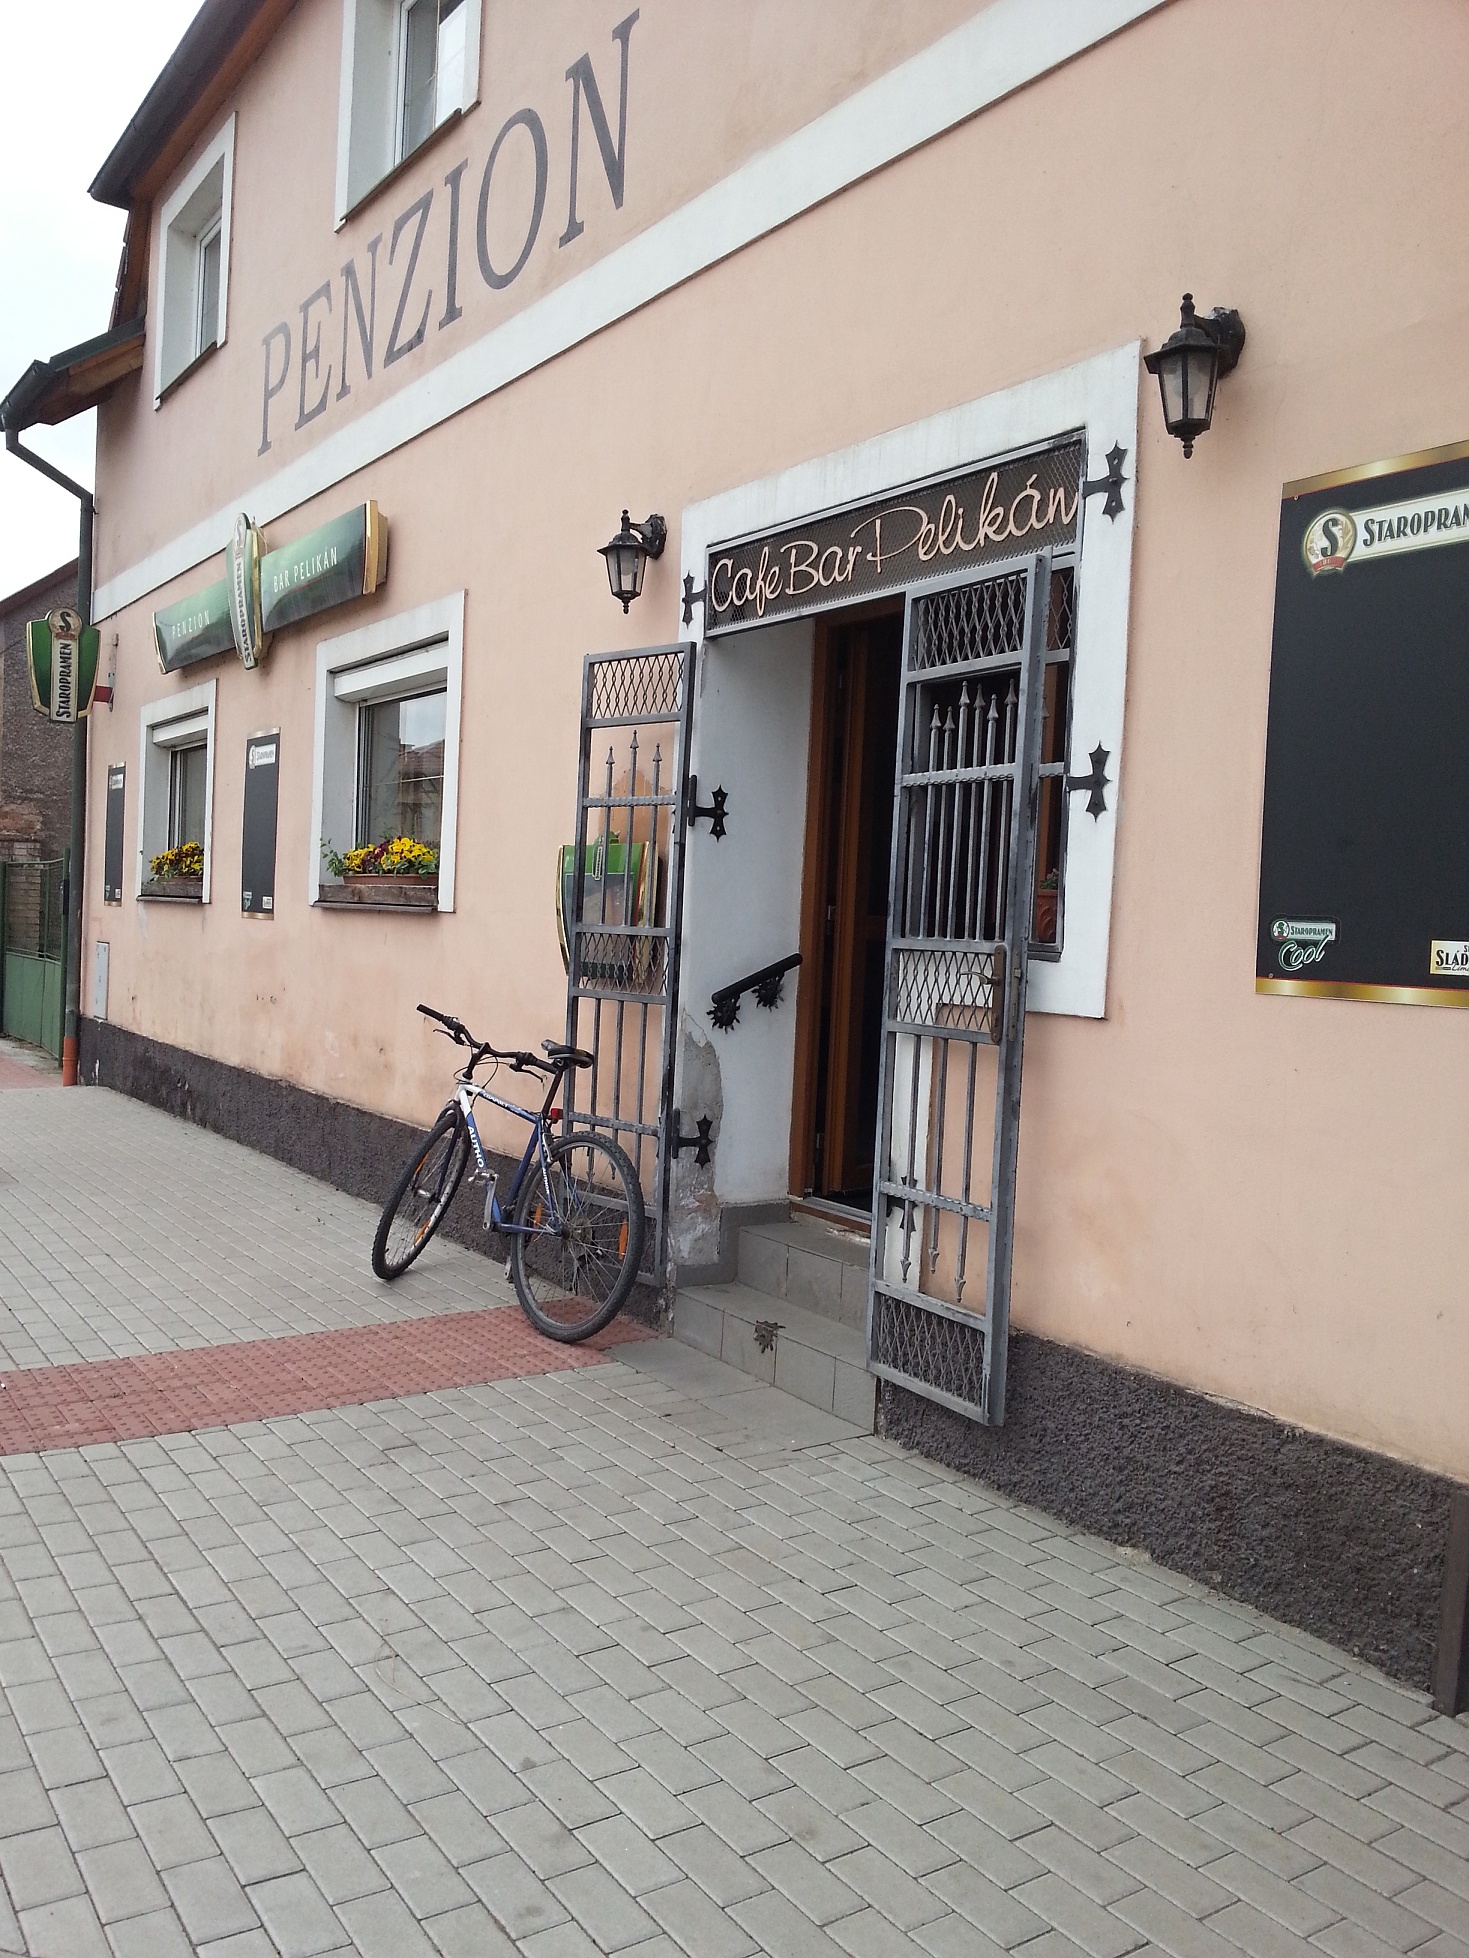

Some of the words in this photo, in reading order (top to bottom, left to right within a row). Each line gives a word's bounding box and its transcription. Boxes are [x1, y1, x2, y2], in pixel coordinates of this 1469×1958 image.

[257, 8, 640, 458] PENZION
[711, 546, 783, 617] Cafe
[780, 540, 862, 595] Bar
[850, 472, 1079, 574] Pelikán
[273, 575, 290, 593] BAR
[293, 546, 337, 583] PELIKÁN
[172, 610, 210, 640] PENZION
[56, 642, 72, 719] STAROPRAMEN
[1278, 934, 1331, 971] Cool
[1290, 926, 1333, 937] STAROPRAMEN
[467, 1125, 485, 1168] AUTHO
